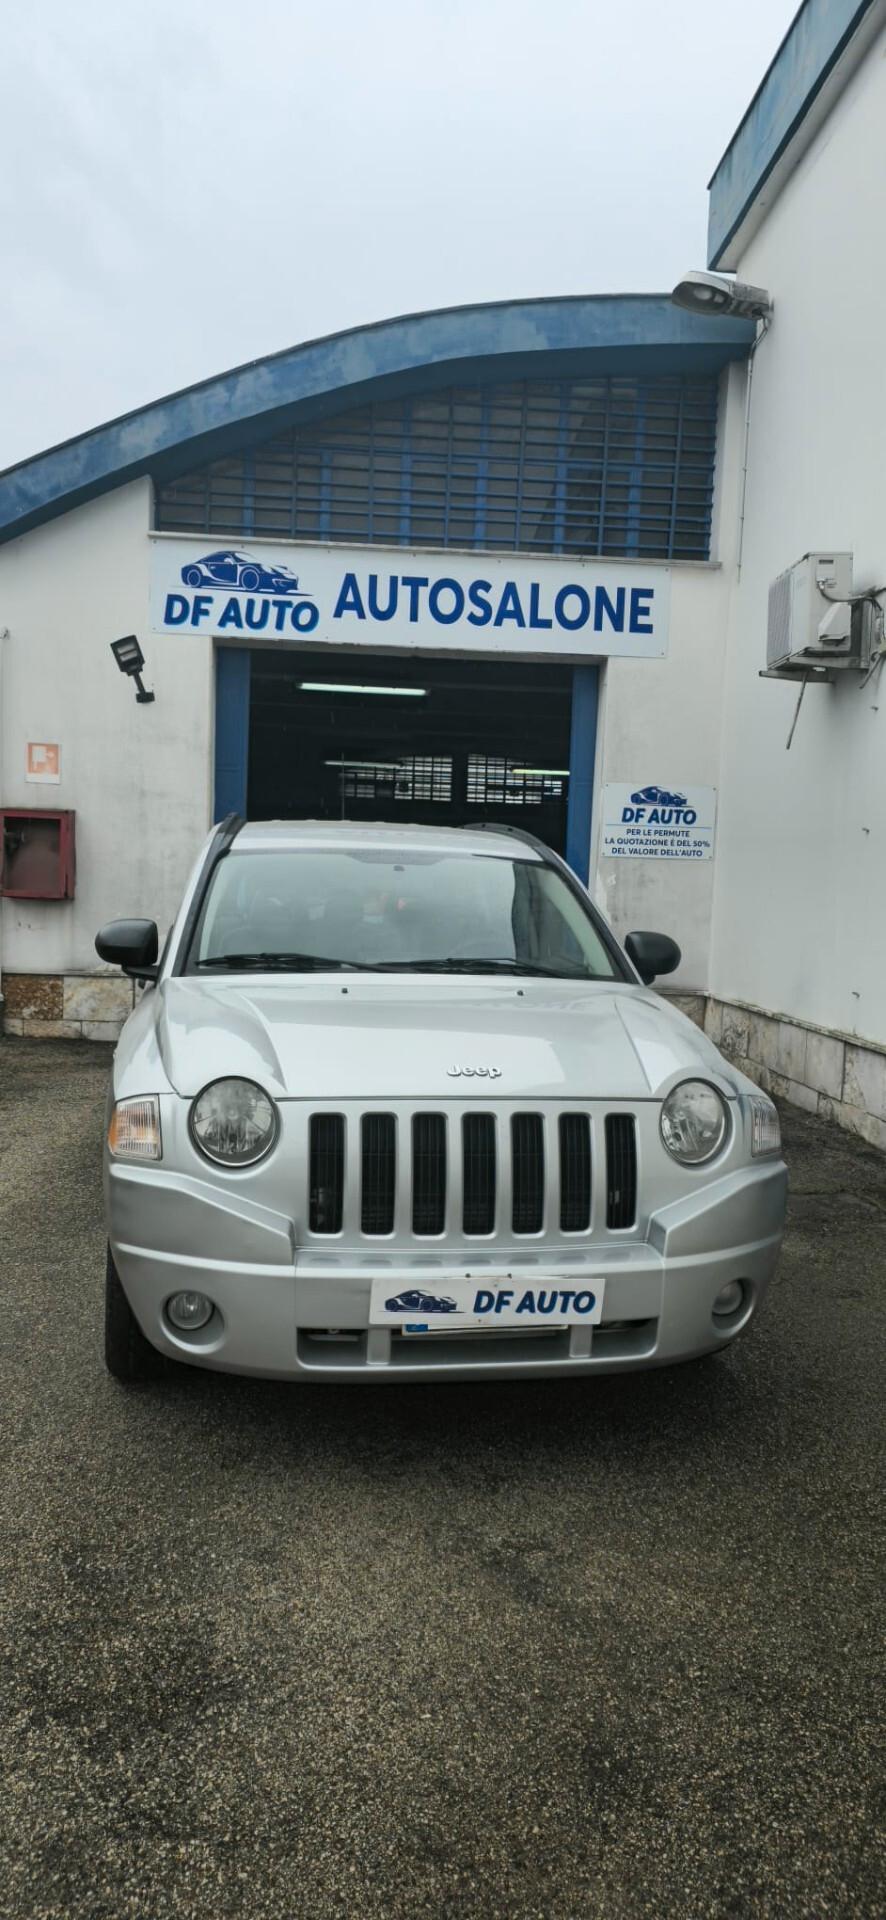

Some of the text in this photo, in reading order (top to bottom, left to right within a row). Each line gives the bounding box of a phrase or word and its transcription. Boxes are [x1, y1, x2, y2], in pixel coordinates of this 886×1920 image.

[333, 573, 654, 634] AUTOSALONE
[163, 594, 319, 632] DF AUTO
[622, 807, 697, 825] DF AUTO
[626, 828, 641, 836] PER
[654, 829, 691, 838] PERMUTE
[617, 838, 668, 847] QUOTAZIONE
[677, 839, 691, 847] DEL
[693, 840, 710, 848] 50%
[612, 847, 703, 857] DEL VALORE DELL'AUTO
[446, 1064, 502, 1079] Jeep
[473, 1290, 596, 1314] DF AUTO
